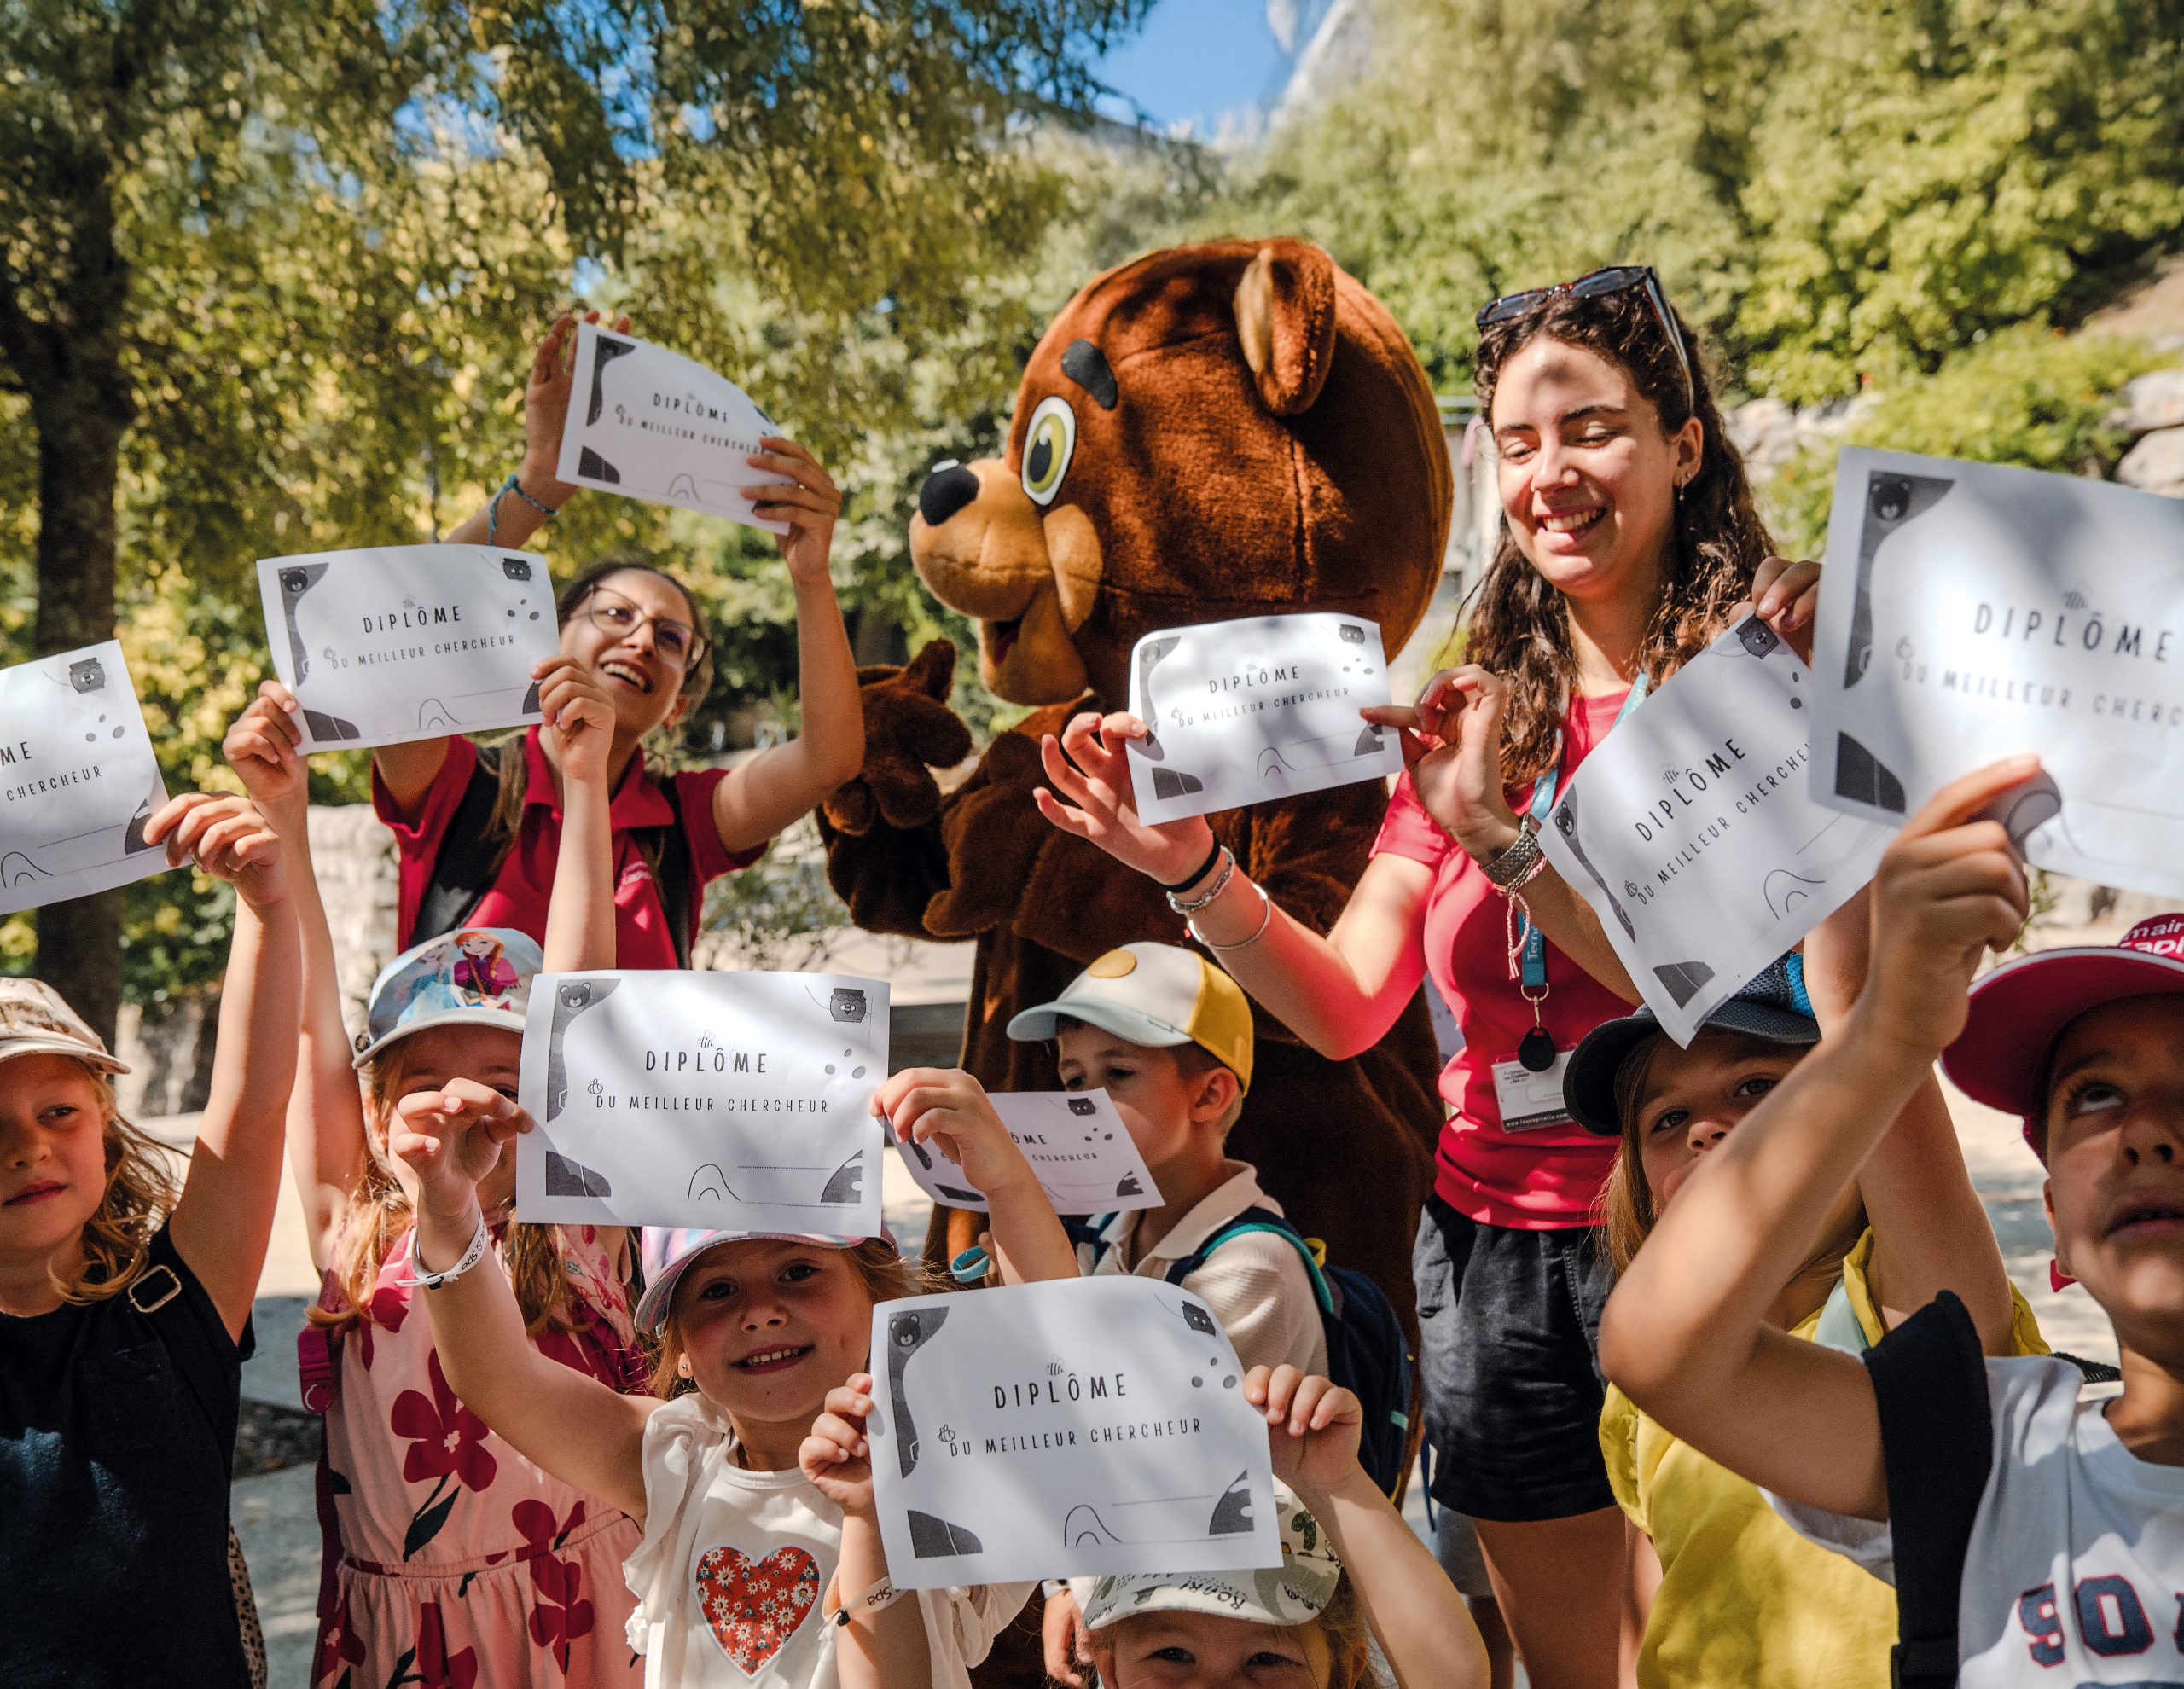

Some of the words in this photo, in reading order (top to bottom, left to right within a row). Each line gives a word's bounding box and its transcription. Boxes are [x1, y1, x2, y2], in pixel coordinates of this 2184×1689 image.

[363, 606, 461, 633] DIPLÔME
[1974, 602, 2172, 661] DIPLÔME
[332, 658, 348, 670] DU
[358, 647, 425, 665] MEILLEUR
[434, 635, 514, 654] CHERCHEUR
[1210, 666, 1299, 693] DIPLÔME
[1902, 661, 1928, 683] DU
[1943, 669, 2071, 708] MEILLEUR
[1179, 717, 1194, 727] DU
[1203, 701, 1264, 722] MEILLEUR
[1274, 688, 1350, 707] CHERCHEUR
[7, 766, 102, 801] CHERCHEUR
[1635, 739, 1746, 841] DIPLÔME
[1638, 885, 1654, 905] DU
[1658, 817, 1731, 885] MEILLEUR
[646, 1048, 767, 1073] DIPLÔME
[596, 1095, 616, 1108] DU
[630, 1096, 714, 1110] MEILLEUR
[728, 1099, 828, 1112] CHERCHEUR
[994, 1373, 1126, 1408] DIPLÔME
[950, 1442, 971, 1457] DU
[985, 1431, 1076, 1454] MEILLEUR
[1090, 1418, 1201, 1442] CHERCHEUR
[867, 1586, 892, 1605] Spa
